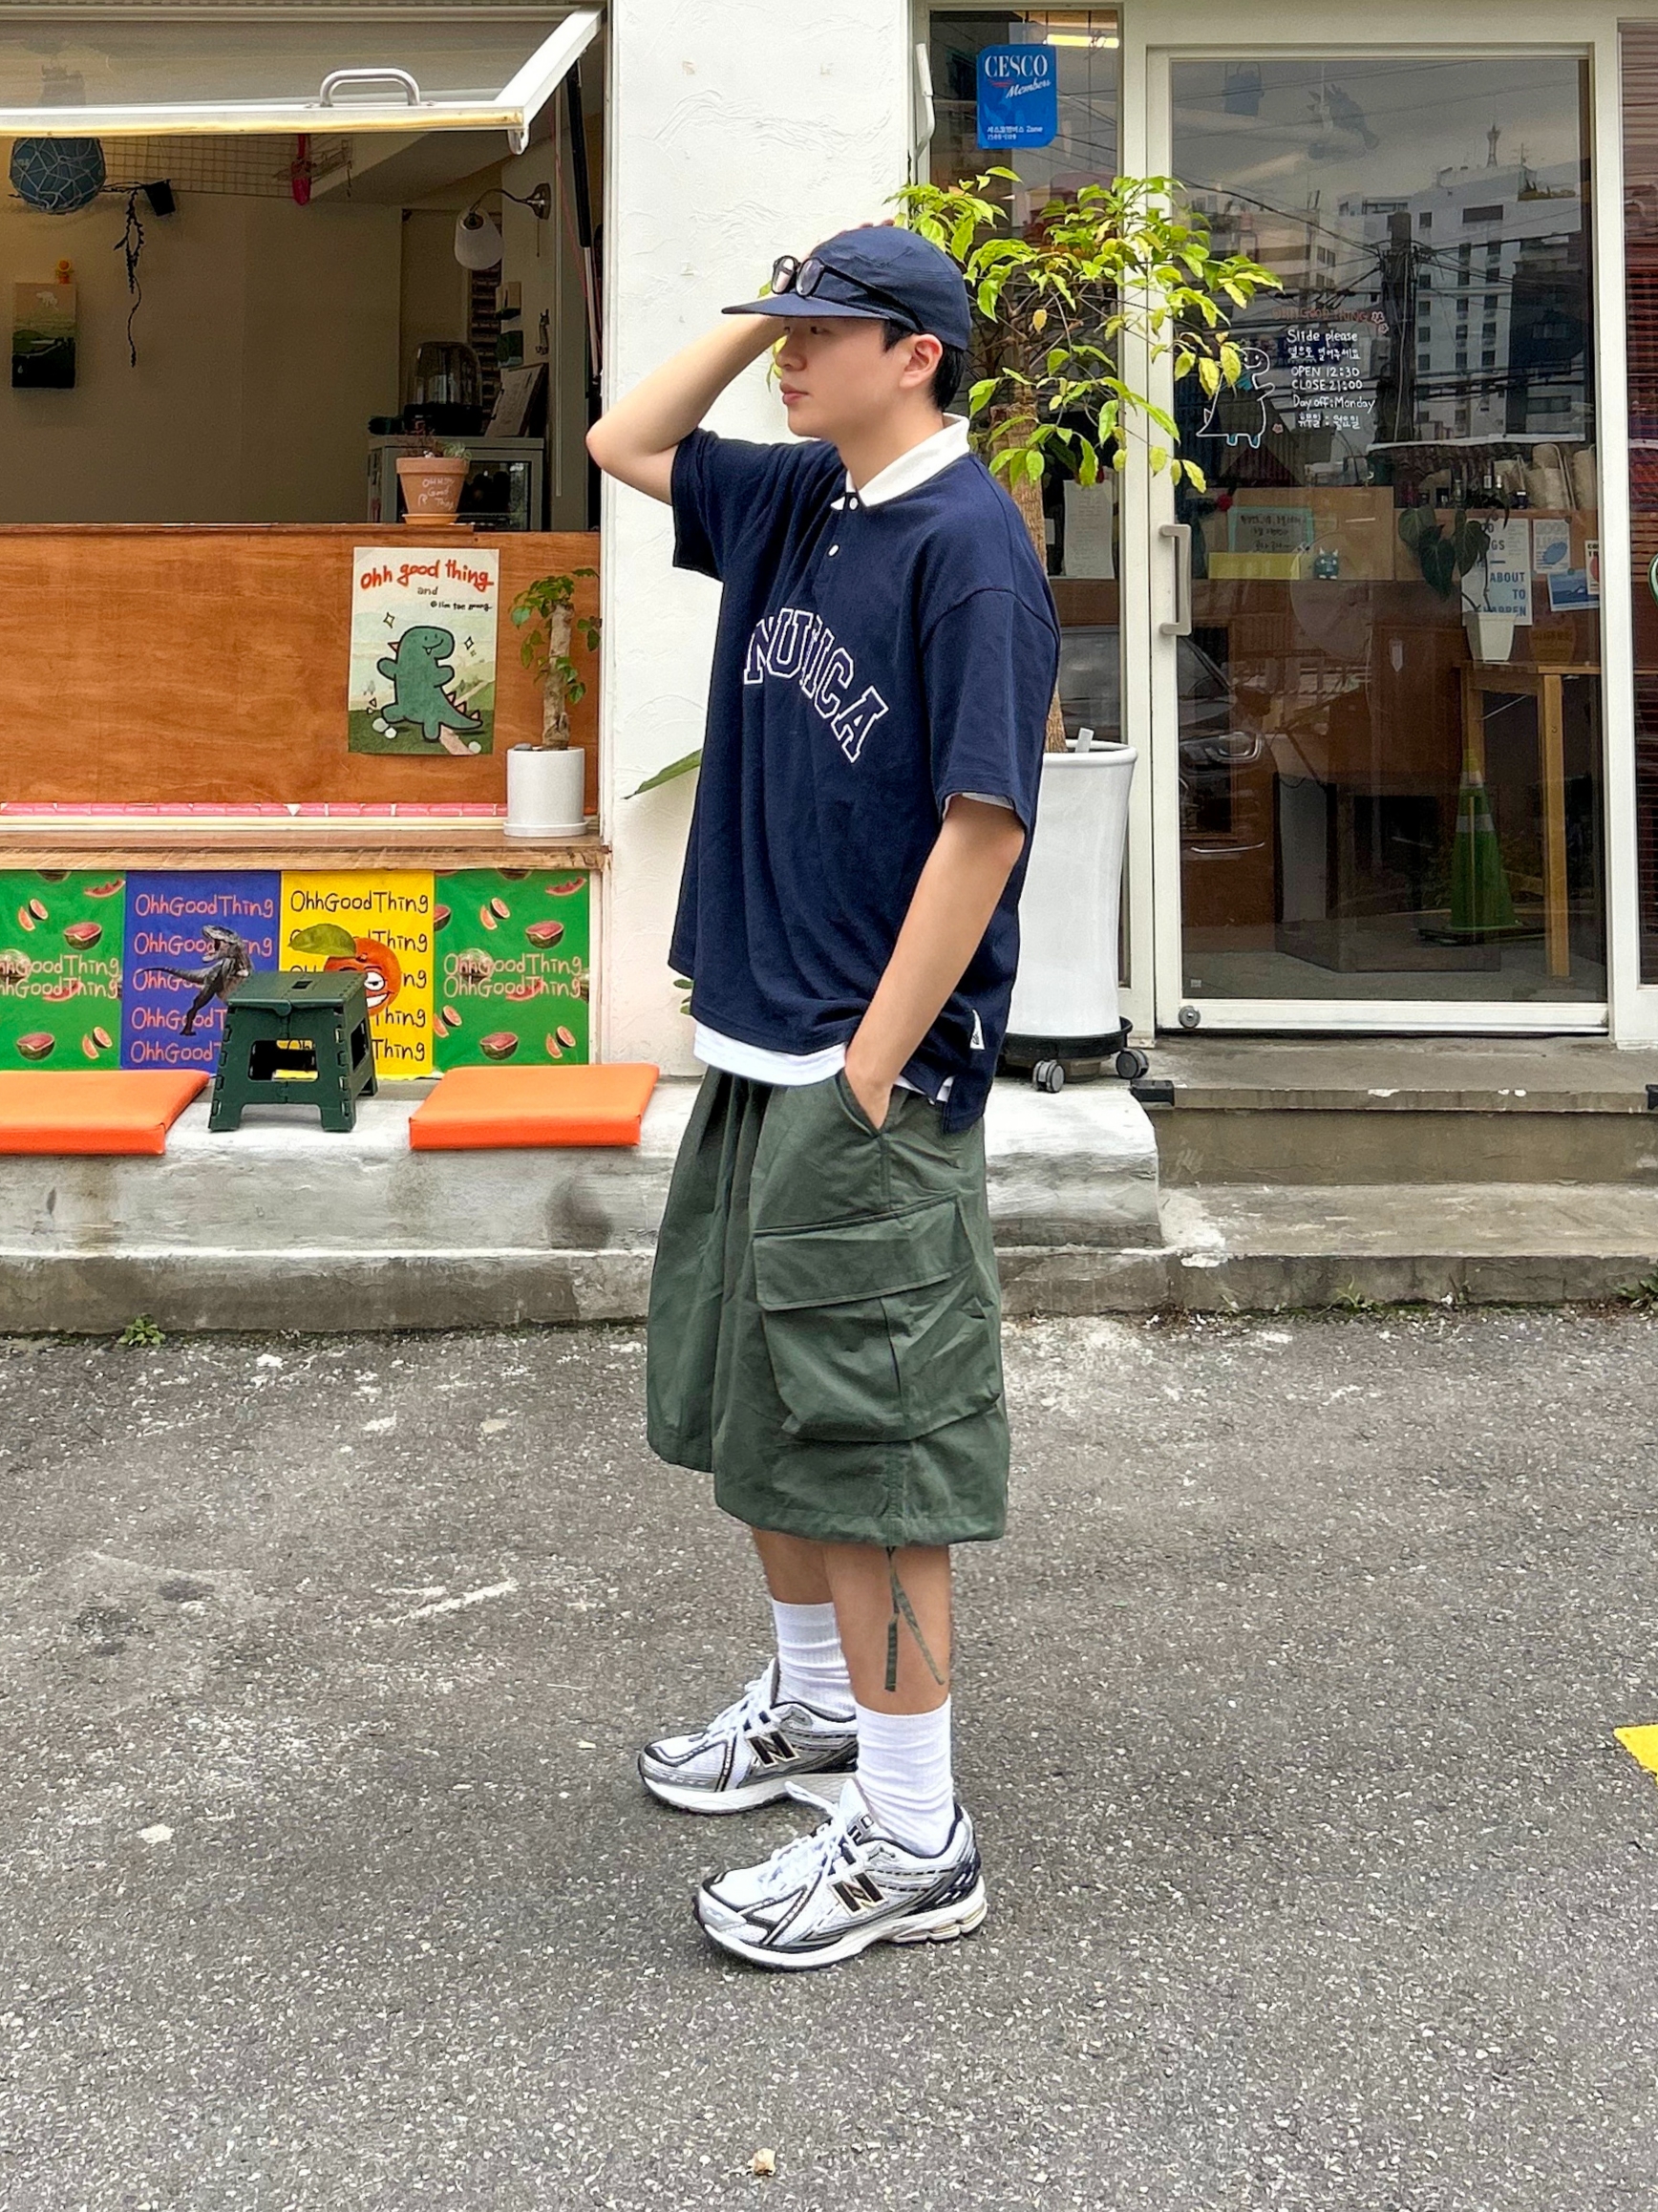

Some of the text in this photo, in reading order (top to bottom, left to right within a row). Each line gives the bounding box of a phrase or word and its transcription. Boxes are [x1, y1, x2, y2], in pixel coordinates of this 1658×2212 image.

[985, 54, 1049, 77] CESCO
[1286, 329, 1358, 349] Slide please
[1290, 366, 1360, 378] OPEN 12:30
[1291, 379, 1364, 393] CLOSE 21:00
[1292, 393, 1312, 411] Day
[396, 558, 441, 586] good
[444, 558, 495, 593] thing
[1490, 572, 1525, 583] ABOUT
[417, 585, 438, 595] and
[1512, 588, 1526, 600] TO
[135, 893, 274, 919] OhhGoodThing
[290, 889, 429, 914] OhhGoodThing
[443, 952, 583, 976] OhhGoodThing
[443, 974, 582, 999] OhhGoodThing
[746, 1728, 801, 1769] N
[826, 1869, 888, 1917] N
